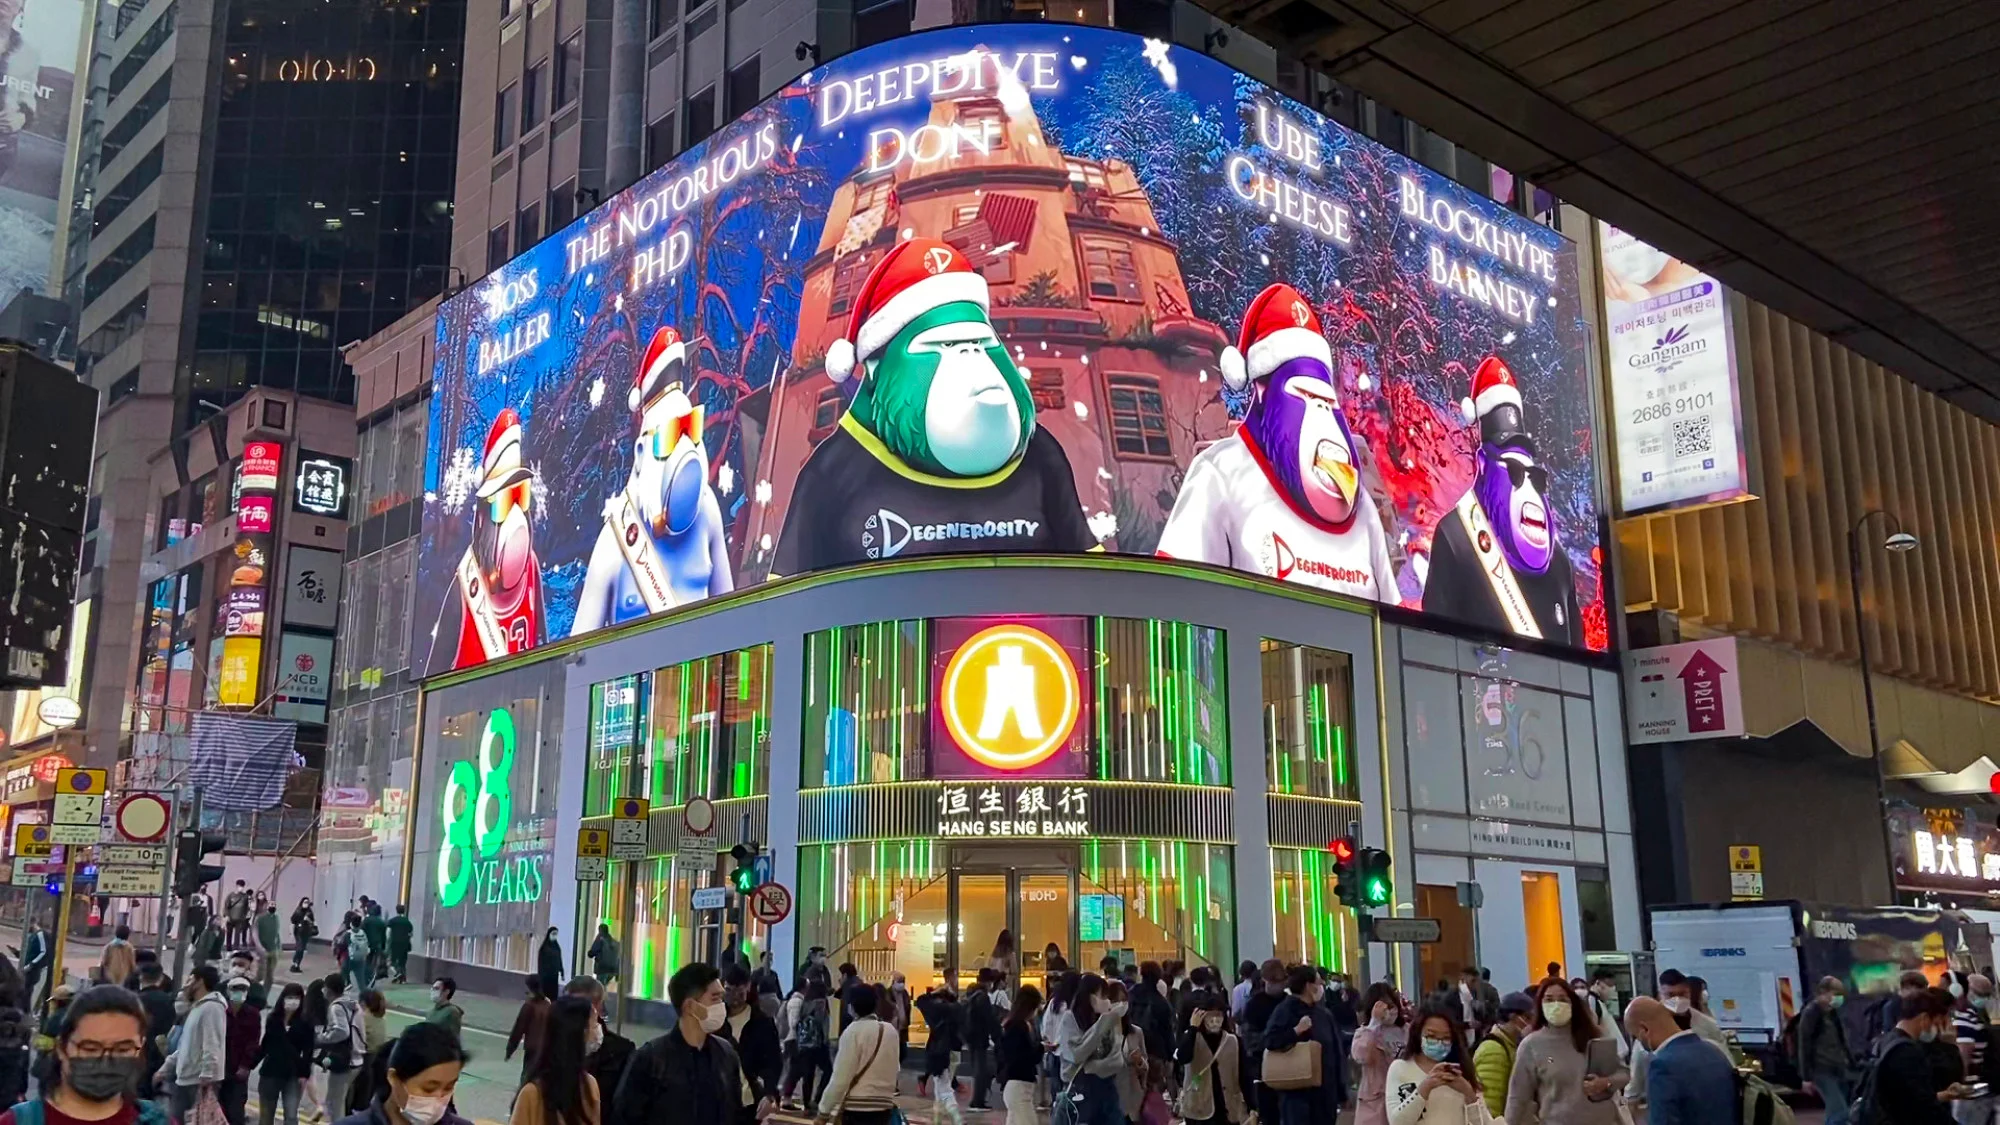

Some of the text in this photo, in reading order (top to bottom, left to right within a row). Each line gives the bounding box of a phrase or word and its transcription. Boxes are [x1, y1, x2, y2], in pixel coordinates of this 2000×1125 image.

[820, 51, 1060, 128] DEEPDIVE
[868, 119, 992, 174] DON
[1259, 106, 1321, 171] UBE
[566, 122, 776, 275] THE NOTORIOUS
[1229, 157, 1351, 244] CHEESE
[1400, 176, 1557, 283] BLOCKHYPE
[632, 230, 690, 292] PHD
[1430, 246, 1537, 323] BARNEY
[478, 313, 550, 375] BALLER
[1628, 338, 1707, 368] Gangnam
[1632, 391, 1714, 424] 2686 9101
[1640, 655, 1671, 667] minute
[288, 673, 319, 685] NCB
[1693, 680, 1716, 711] PRET
[1638, 720, 1677, 729] MANNING
[1645, 727, 1671, 736] HOUSE
[86, 797, 95, 807] 7
[437, 707, 518, 908] 88
[937, 785, 1089, 815] 恒生銀行
[84, 812, 94, 822] 7
[938, 820, 1089, 836] HANG SENG BANK
[137, 850, 151, 860] 10
[153, 851, 163, 860] m
[473, 855, 544, 905] YEARS
